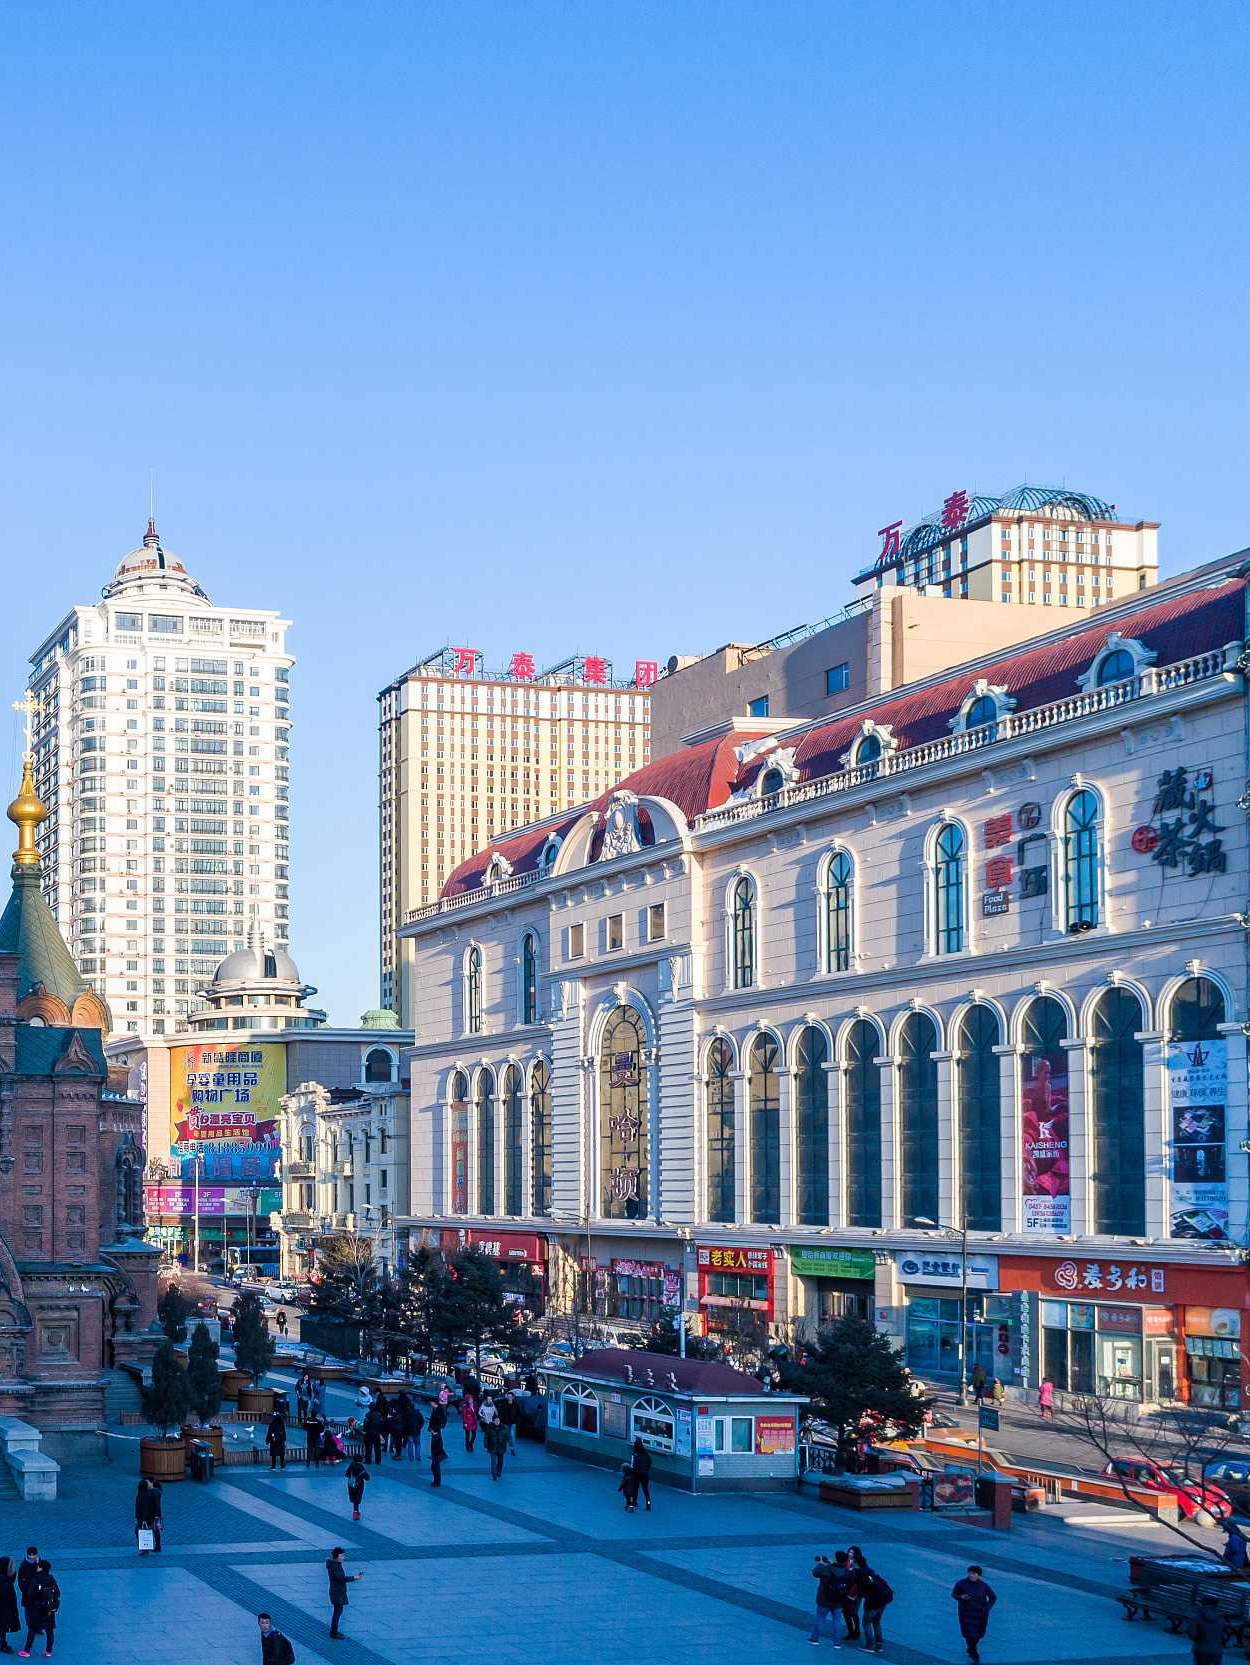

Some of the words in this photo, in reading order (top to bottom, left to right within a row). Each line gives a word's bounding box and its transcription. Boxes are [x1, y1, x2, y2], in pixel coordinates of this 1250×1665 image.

[877, 489, 969, 560] 万泰
[452, 647, 658, 687] 万泰集团
[192, 1089, 250, 1103] 购物广场
[1025, 1140, 1067, 1149] KAISHENG
[1027, 1218, 1039, 1227] 5F
[710, 1250, 747, 1267] 老实人
[1082, 1263, 1148, 1291] 麦多和
